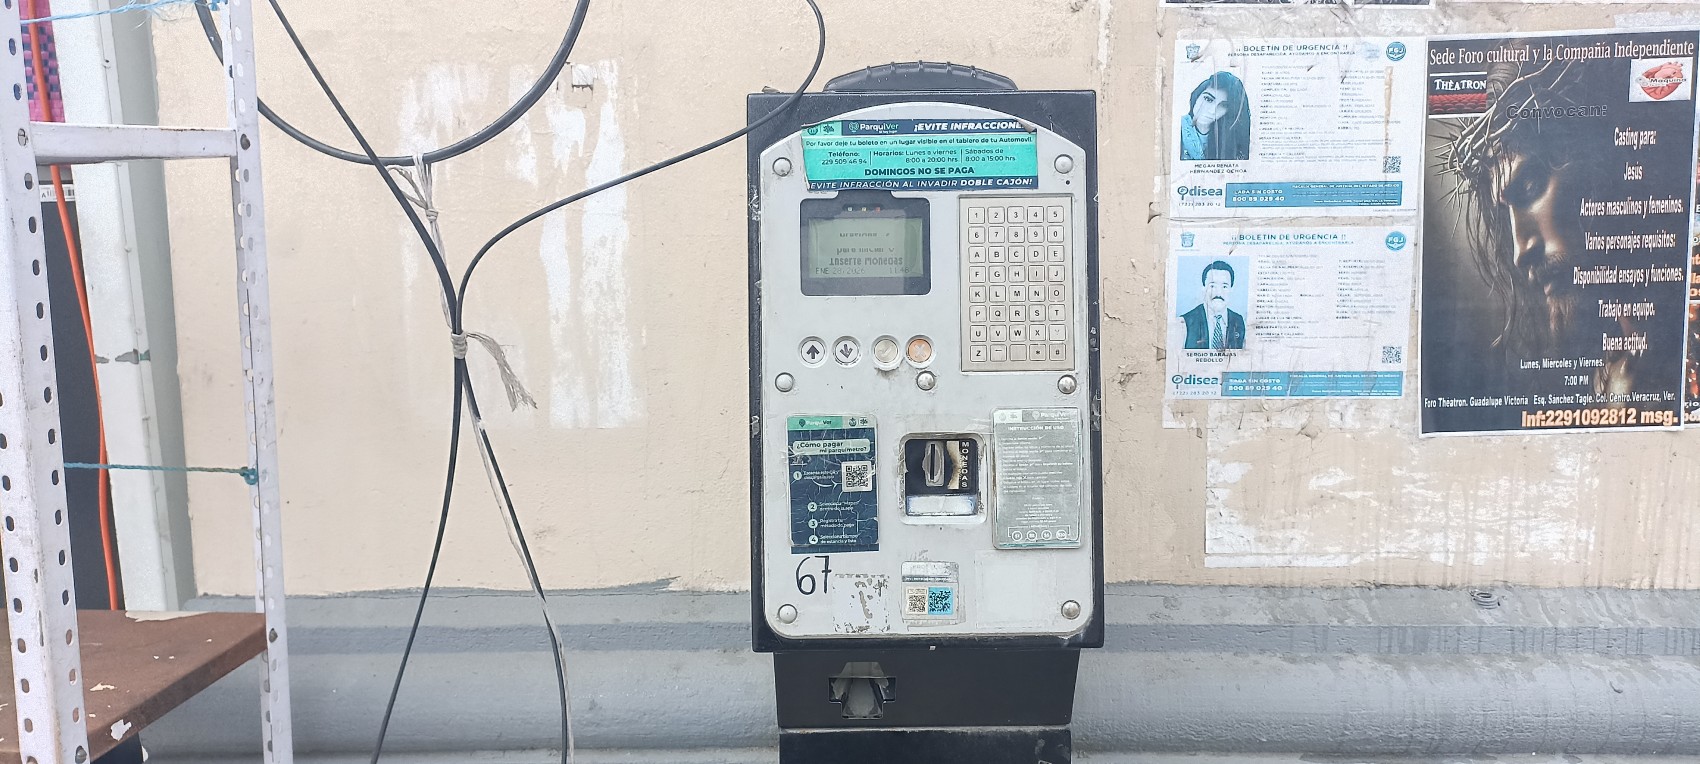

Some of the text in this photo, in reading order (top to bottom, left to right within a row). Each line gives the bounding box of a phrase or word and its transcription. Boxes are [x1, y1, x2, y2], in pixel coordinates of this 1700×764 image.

[1430, 39, 1694, 65] Sede Foro cultural y la Compañía Independiente
[1506, 104, 1608, 120] Convocan:
[860, 123, 898, 132] ParquiVer
[1614, 126, 1657, 150] Casting para:
[864, 168, 915, 176] DOMINGOS
[1624, 162, 1643, 180] Jesús
[840, 180, 900, 188] INFRACCIÓN
[1580, 198, 1605, 216] Actores
[1606, 196, 1642, 215] masculinos
[1643, 200, 1648, 219] y
[1648, 195, 1683, 214] femeninos.
[1585, 230, 1676, 254] Varios personajes requisitos:
[1573, 264, 1684, 288] Disponibilidad ensayos y funciones.
[1598, 298, 1655, 322] Trabajo en equipo.
[1602, 332, 1648, 350] Buena actitud.
[1520, 357, 1604, 370] Lunes, Miércoles y Viernes.
[1564, 375, 1589, 386] 7:00 PM
[1424, 398, 1436, 408] Foro
[1470, 396, 1502, 408] Guadalupe
[1504, 395, 1528, 406] Victoria
[1534, 395, 1546, 406] Esq.
[1548, 393, 1574, 404] Sánchez
[1663, 391, 1676, 401] Ver.
[1522, 408, 1637, 427] Inf:2291092812
[1640, 410, 1678, 426] msg.
[961, 442, 970, 488] MONEDAS
[796, 555, 832, 595] 67
